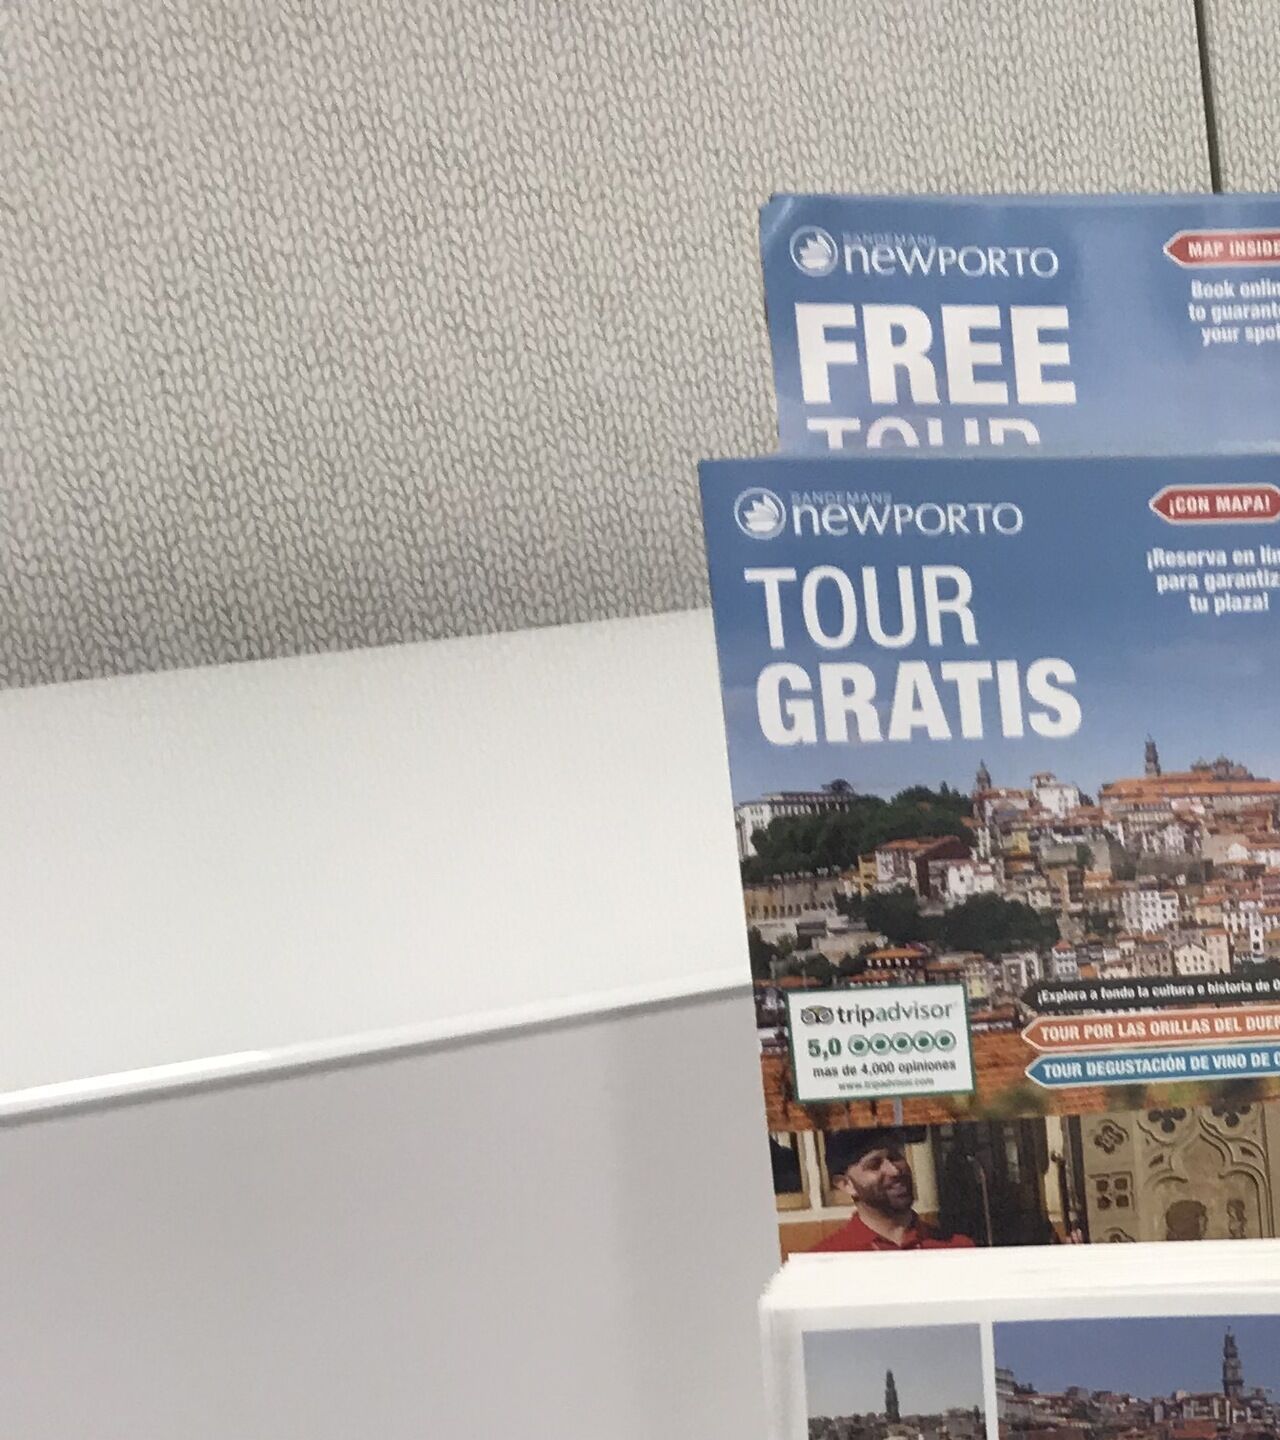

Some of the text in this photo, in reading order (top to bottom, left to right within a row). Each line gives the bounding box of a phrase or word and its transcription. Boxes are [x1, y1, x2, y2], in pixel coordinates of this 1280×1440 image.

[1188, 241, 1225, 258] MAP
[1191, 279, 1235, 298] Book
[1188, 302, 1206, 321] to
[1201, 326, 1240, 347] your
[794, 302, 1077, 406] FREE
[1169, 495, 1271, 516] ¡CON MAPA!
[1147, 547, 1227, 572] ¡Reserva
[1232, 549, 1255, 565] en
[1157, 573, 1199, 594] para
[744, 564, 979, 650] TOUR
[1189, 592, 1269, 616] tu plaza!
[756, 657, 1082, 746] GRATIS
[1037, 988, 1087, 1005] ¡Explora
[1090, 991, 1098, 1000] a
[1100, 986, 1135, 1000] fondo
[1137, 985, 1149, 998] la
[1152, 982, 1194, 997] cultura
[1198, 985, 1205, 994] e
[1207, 980, 1252, 995] historia
[1255, 978, 1270, 992] de
[838, 1001, 953, 1027] tripadvisor
[1040, 1025, 1080, 1041] TOUR
[1084, 1023, 1114, 1039] POR
[1118, 1021, 1146, 1037] LAS
[1150, 1018, 1210, 1035] ORILLAS
[1214, 1016, 1242, 1032] DEL
[808, 1038, 842, 1060] 5,0
[842, 1065, 857, 1076] de
[899, 1060, 957, 1076] opiniones
[1042, 1062, 1086, 1079] TOUR
[1087, 1054, 1186, 1077] DEGUSTACIÓN
[1190, 1054, 1209, 1071] DE
[1211, 1052, 1247, 1069] VINO
[1250, 1051, 1270, 1067] DE
